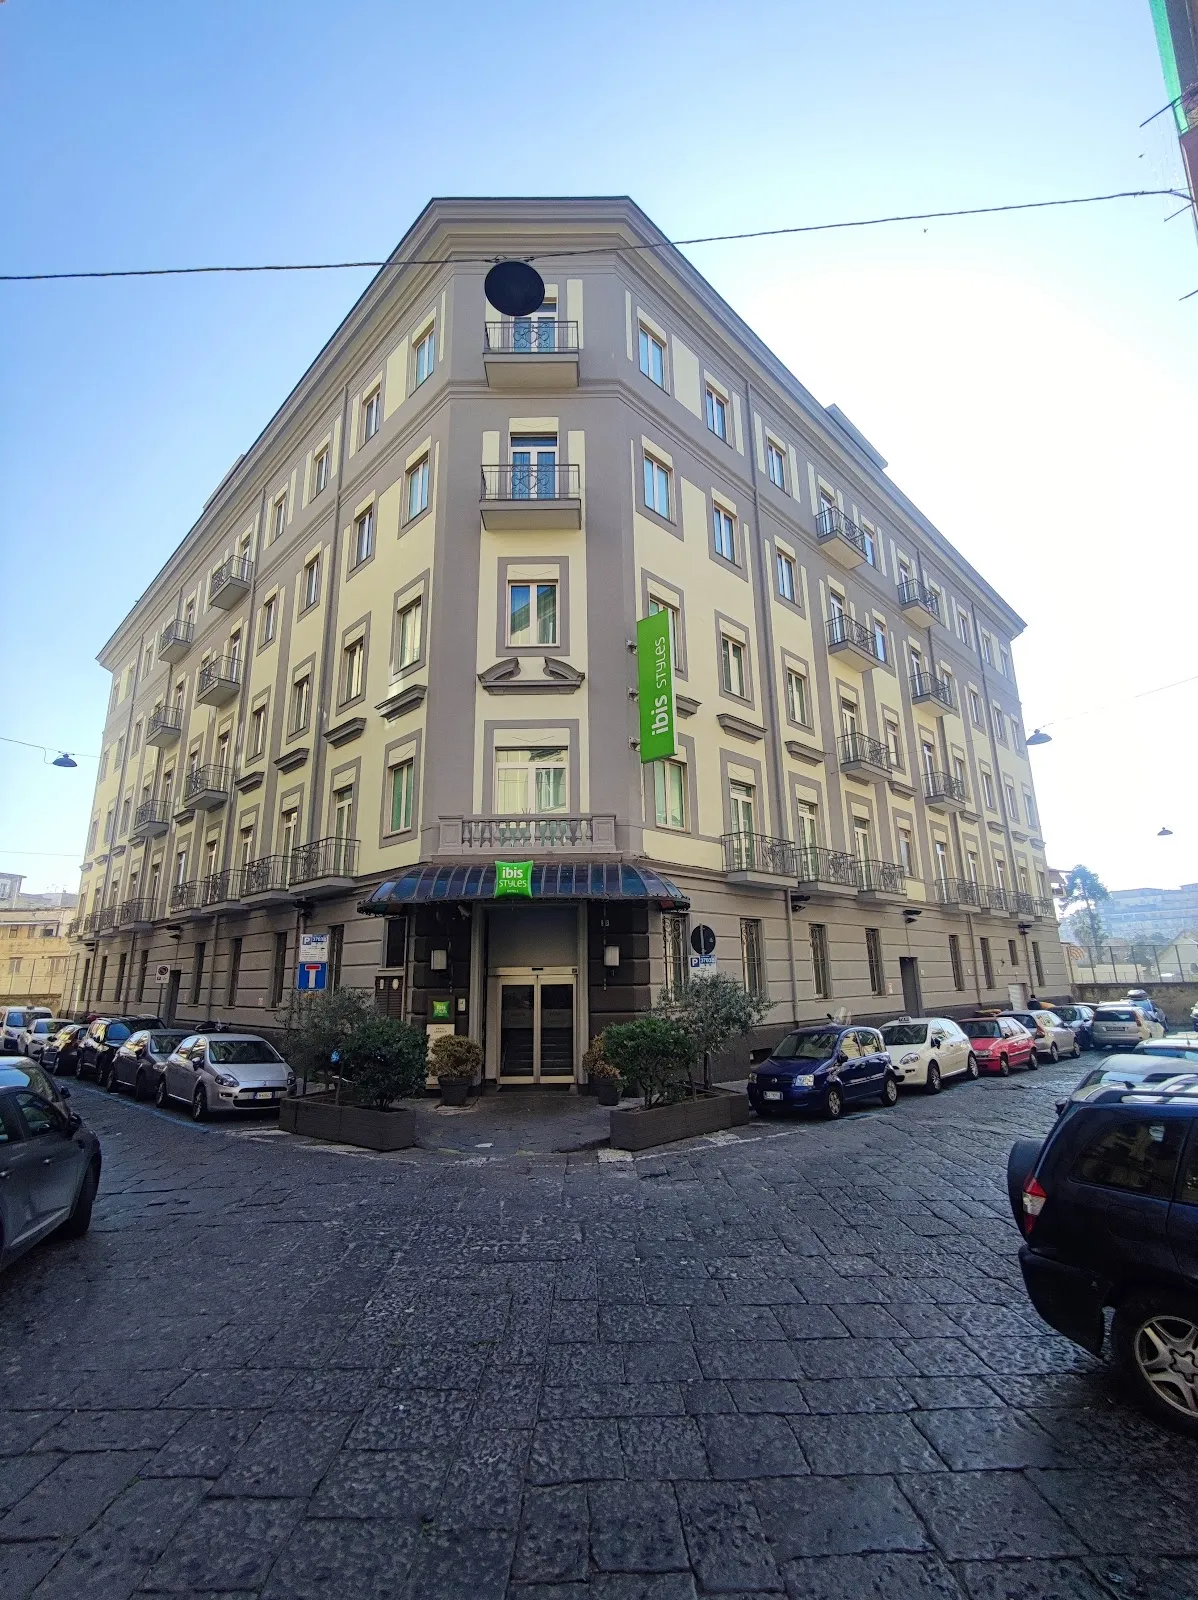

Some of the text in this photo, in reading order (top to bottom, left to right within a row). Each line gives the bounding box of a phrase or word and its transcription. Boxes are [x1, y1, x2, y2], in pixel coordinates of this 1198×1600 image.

[651, 694, 669, 735] ibis
[502, 866, 523, 879] ibis
[303, 937, 310, 945] P
[691, 959, 698, 967] P
